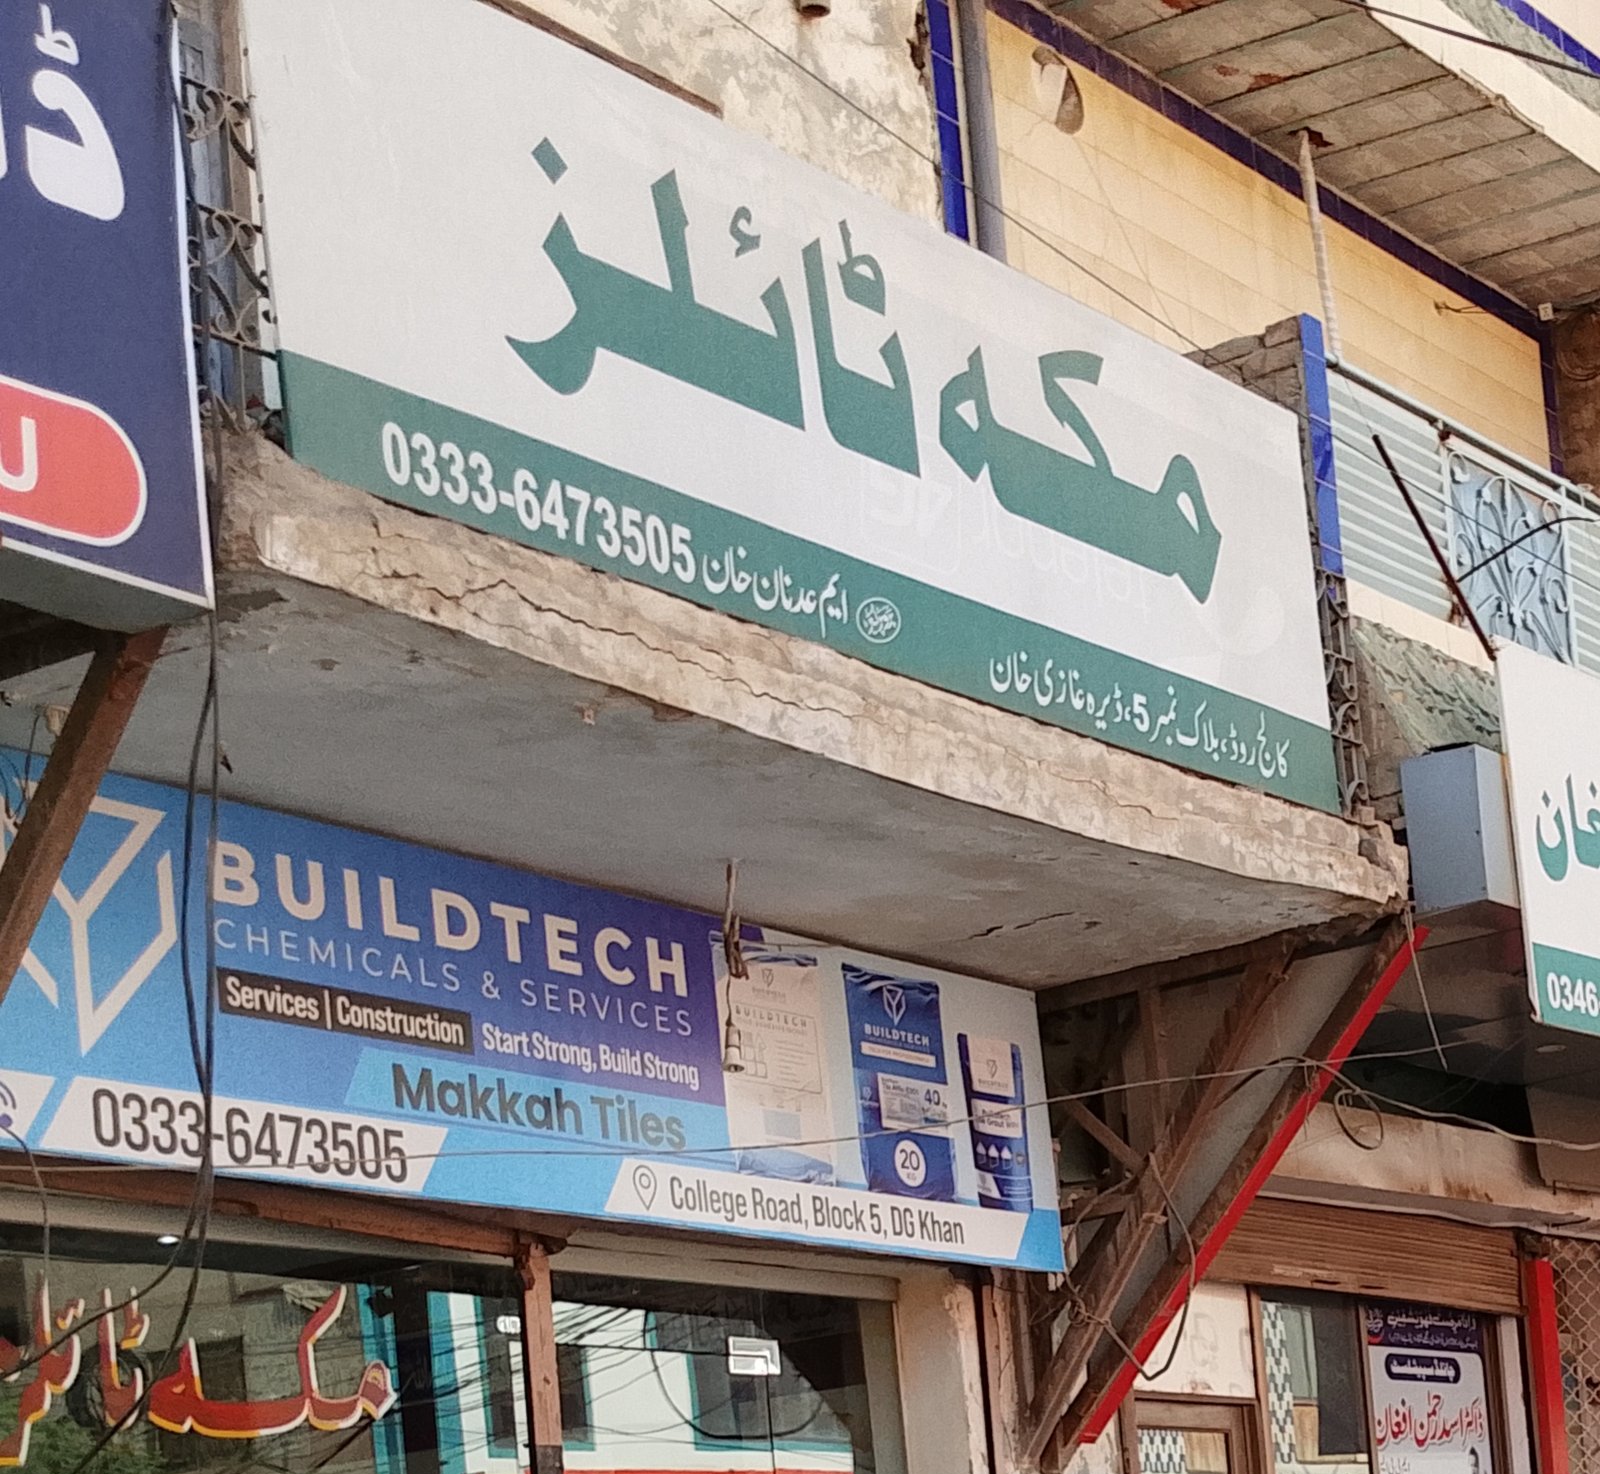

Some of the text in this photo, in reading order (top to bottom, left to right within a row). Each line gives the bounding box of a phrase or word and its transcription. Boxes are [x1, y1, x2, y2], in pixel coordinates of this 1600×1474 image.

[504, 136, 1222, 604] مکہ ٹائلز
[381, 421, 697, 584] 0333-6473505
[702, 546, 753, 594] خان
[753, 565, 818, 614] عدنان
[818, 572, 849, 639] ایم
[989, 650, 1033, 693] خان
[1034, 659, 1085, 711] غازی
[1086, 682, 1123, 730] ڈیرہ
[1149, 685, 1178, 744] نمبر
[1176, 700, 1221, 761] بلاک
[1257, 710, 1290, 779] کالج
[213, 839, 689, 998] BUILDTECH
[214, 918, 693, 1037] CHEMICALS & SERVICES
[226, 976, 321, 1021] Services
[335, 997, 465, 1046] Construction
[482, 1022, 699, 1090] Start Strong, Build Strong
[863, 1023, 930, 1047] BUILDTECH
[91, 1087, 408, 1184] 0333-6473505
[391, 1063, 687, 1152] Makkah Tiles
[899, 1148, 921, 1172] 20
[669, 1175, 965, 1245] College Road, Block 5, DG Khan
[147, 1284, 399, 1439] مکہ
[1462, 1397, 1484, 1446] ڈاکٹر
